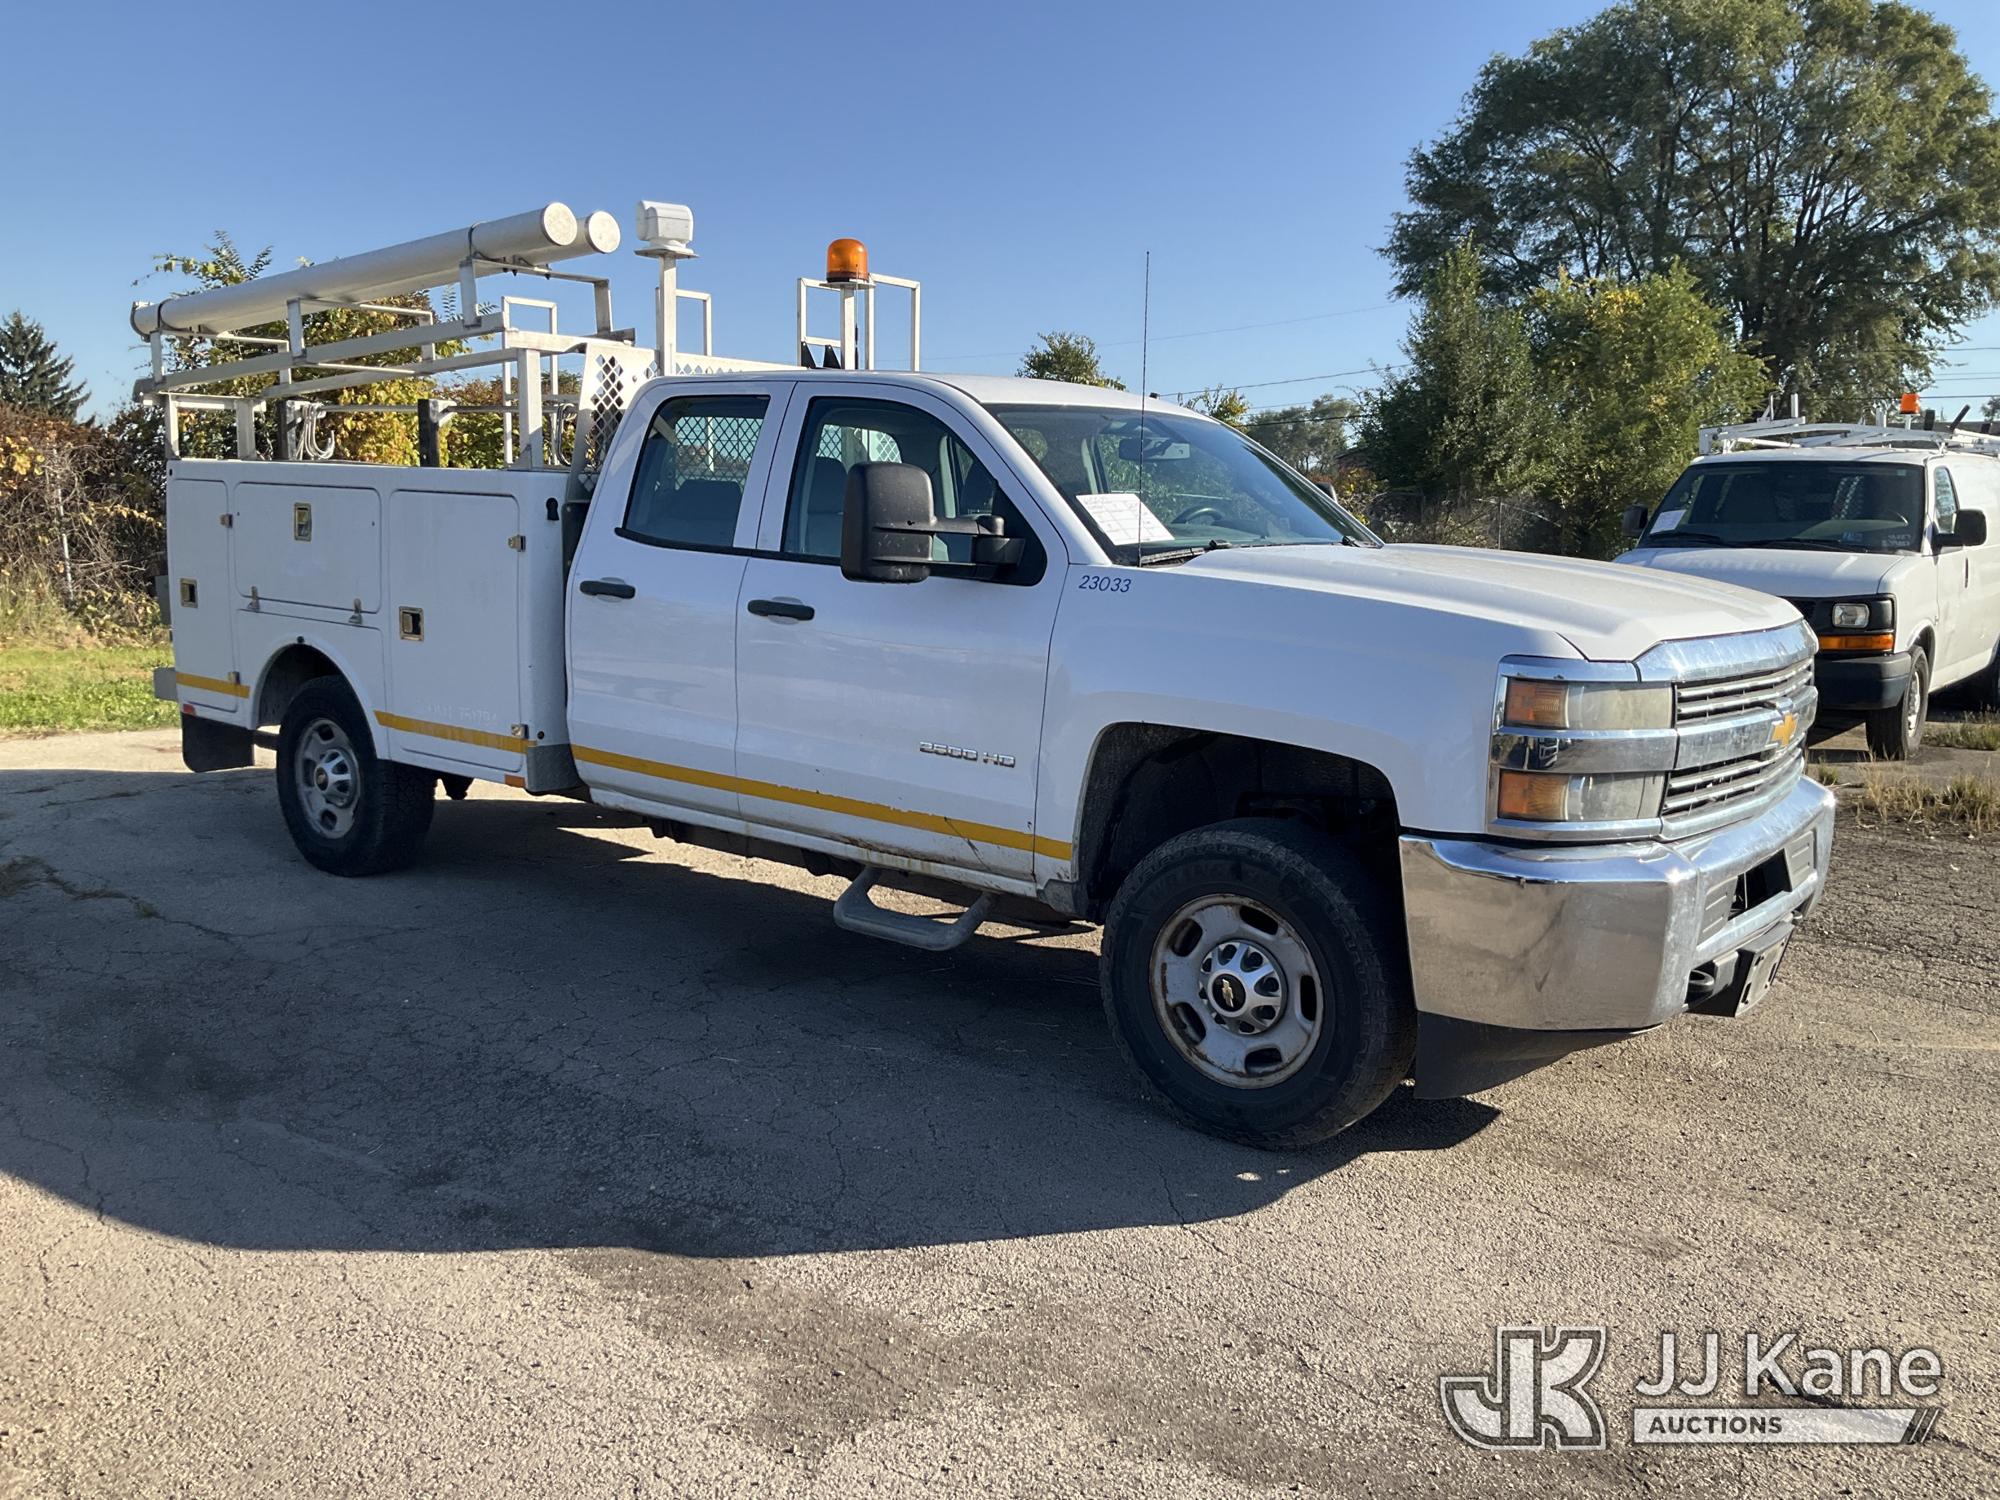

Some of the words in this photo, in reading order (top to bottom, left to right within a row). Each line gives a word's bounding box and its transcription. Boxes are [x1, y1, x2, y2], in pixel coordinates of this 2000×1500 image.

[1079, 575, 1132, 593] 23033
[920, 741, 978, 761] 2500
[983, 752, 1015, 768] HD
